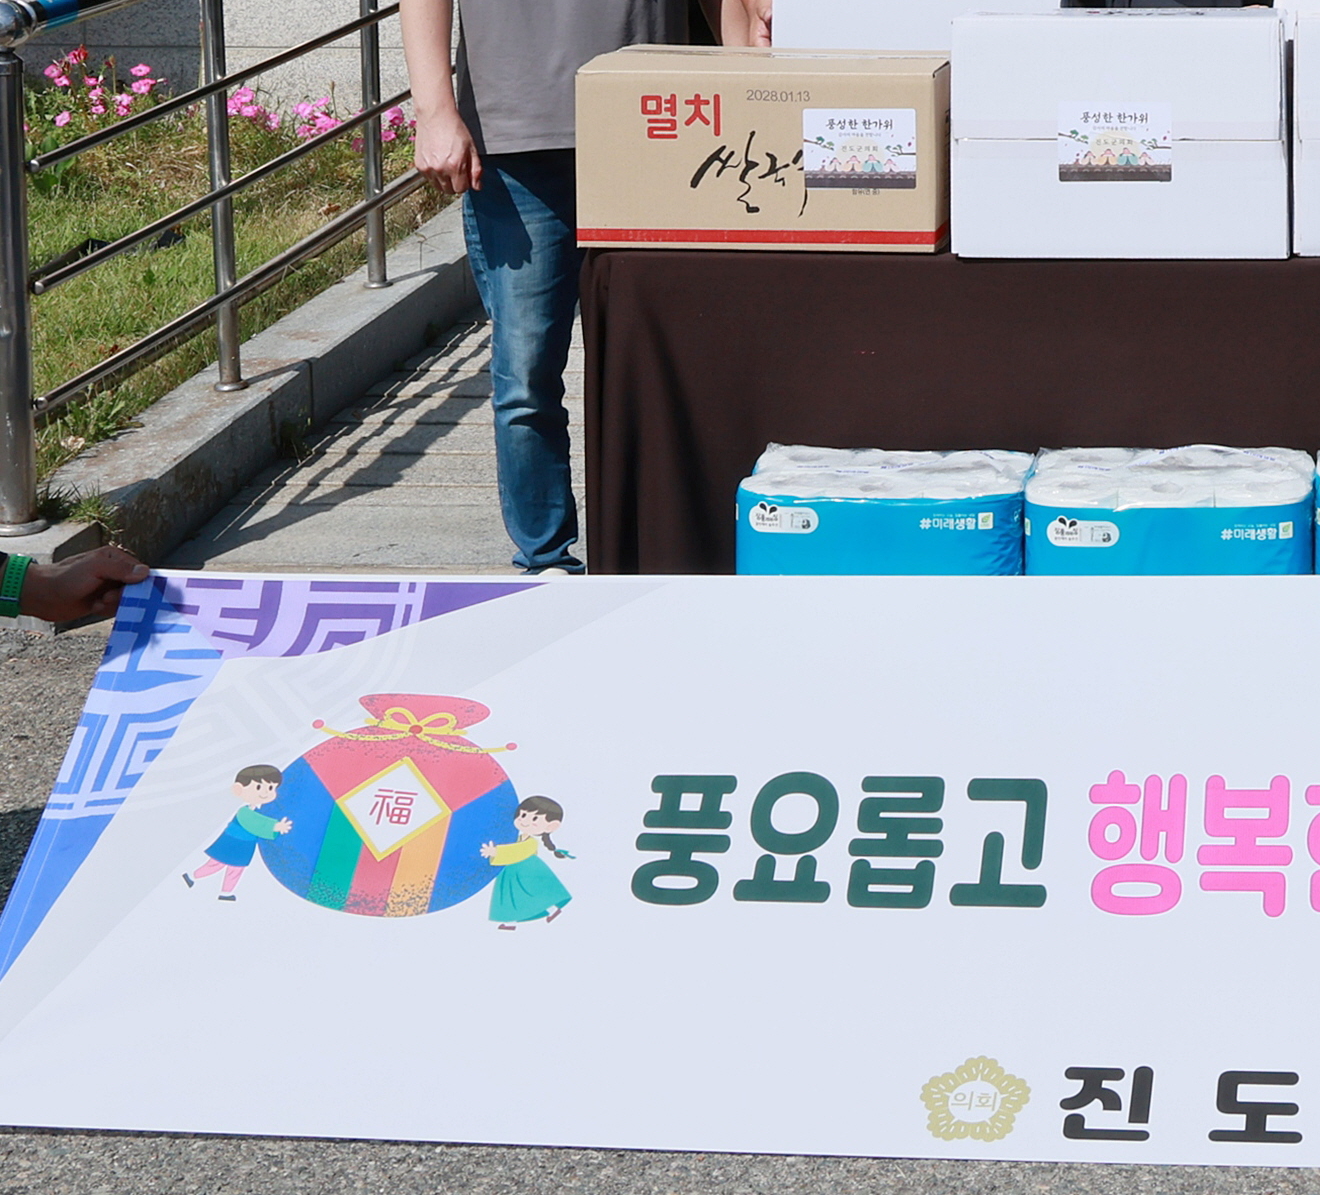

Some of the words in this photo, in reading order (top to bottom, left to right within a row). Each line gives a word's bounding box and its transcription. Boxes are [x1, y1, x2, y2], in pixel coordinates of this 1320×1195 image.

[746, 89, 811, 103] 2028.01.13
[640, 93, 721, 140] 멸치
[1080, 111, 1113, 124] 풍성한
[1117, 112, 1149, 124] 한가위
[826, 119, 858, 130] 풍성한
[862, 119, 893, 130] 한가위
[919, 518, 976, 530] #미래생활
[1221, 528, 1277, 540] #미래생활
[369, 788, 418, 825] 福
[631, 771, 1048, 910] 풍요롭고
[951, 1091, 998, 1111] 의회
